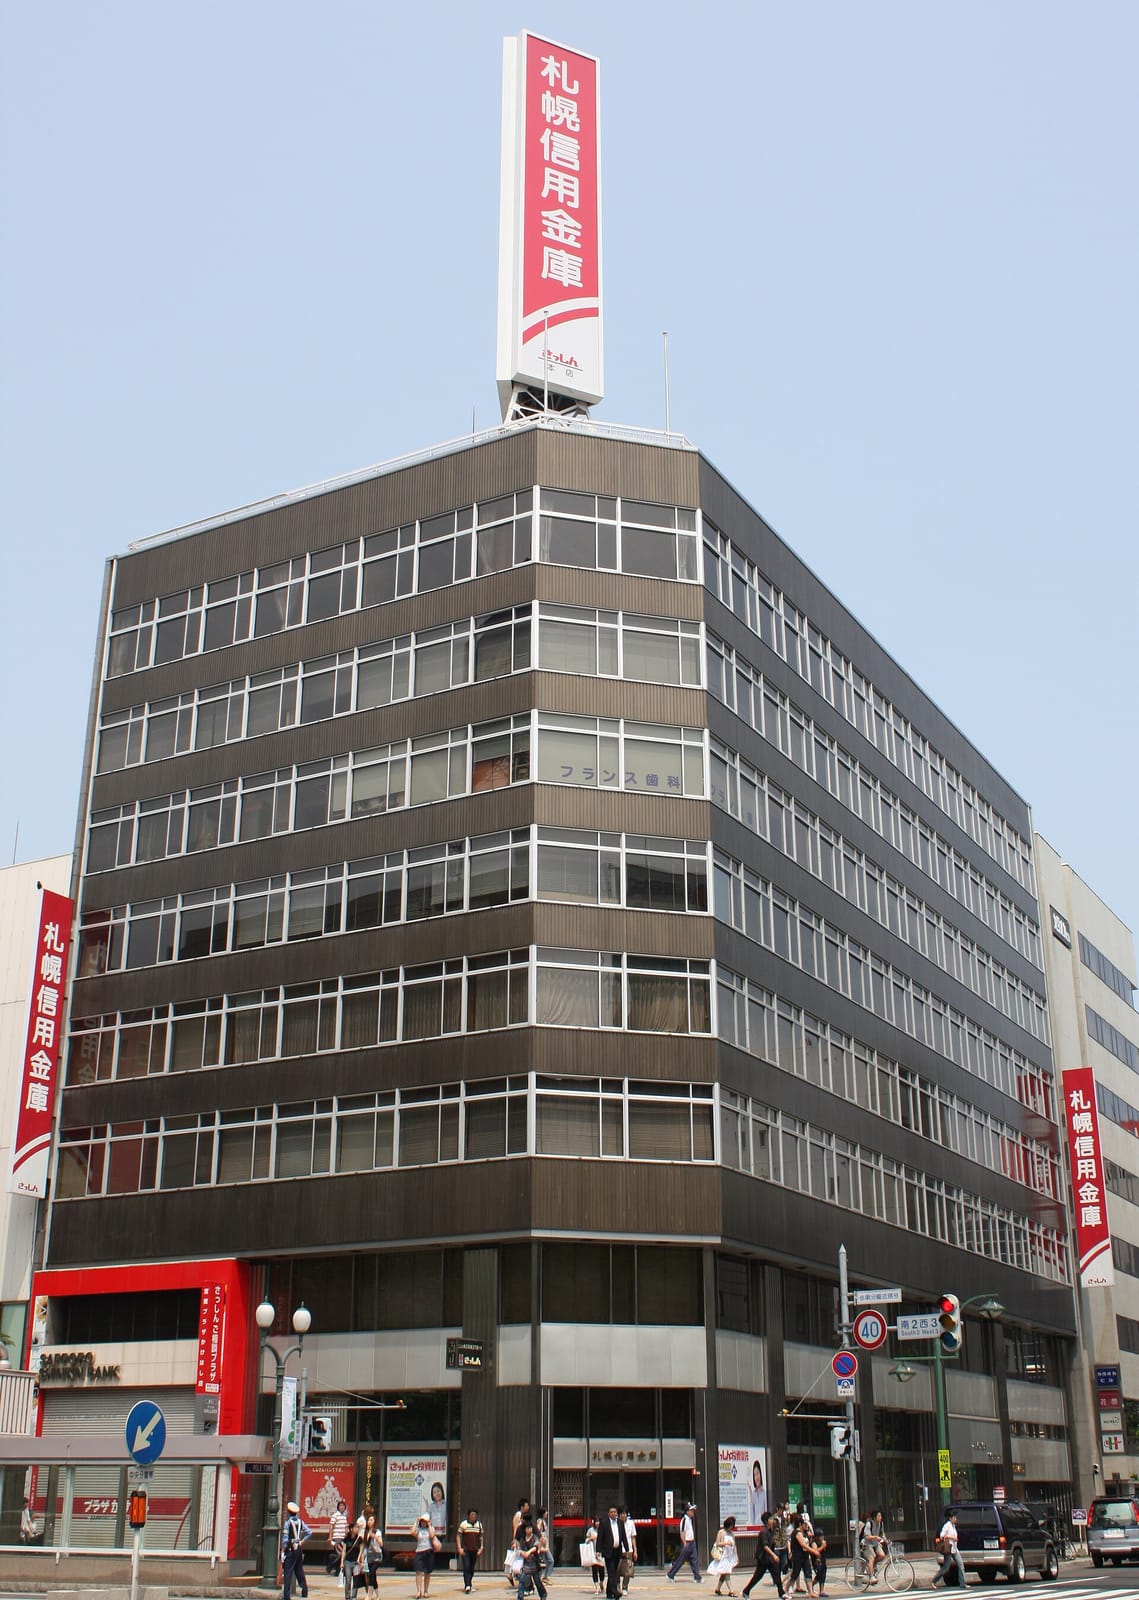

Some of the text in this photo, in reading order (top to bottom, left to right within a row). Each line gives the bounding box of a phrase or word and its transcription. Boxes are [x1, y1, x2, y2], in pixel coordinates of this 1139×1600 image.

[539, 55, 584, 288] 札幌信用金庫
[541, 349, 579, 368] さっしん
[560, 765, 681, 789] フランス歯科
[25, 922, 65, 1113] 札幌信用金庫
[1069, 1090, 1102, 1227] 札幌信用金庫
[17, 1182, 38, 1193] さっしん
[861, 1321, 879, 1338] 40
